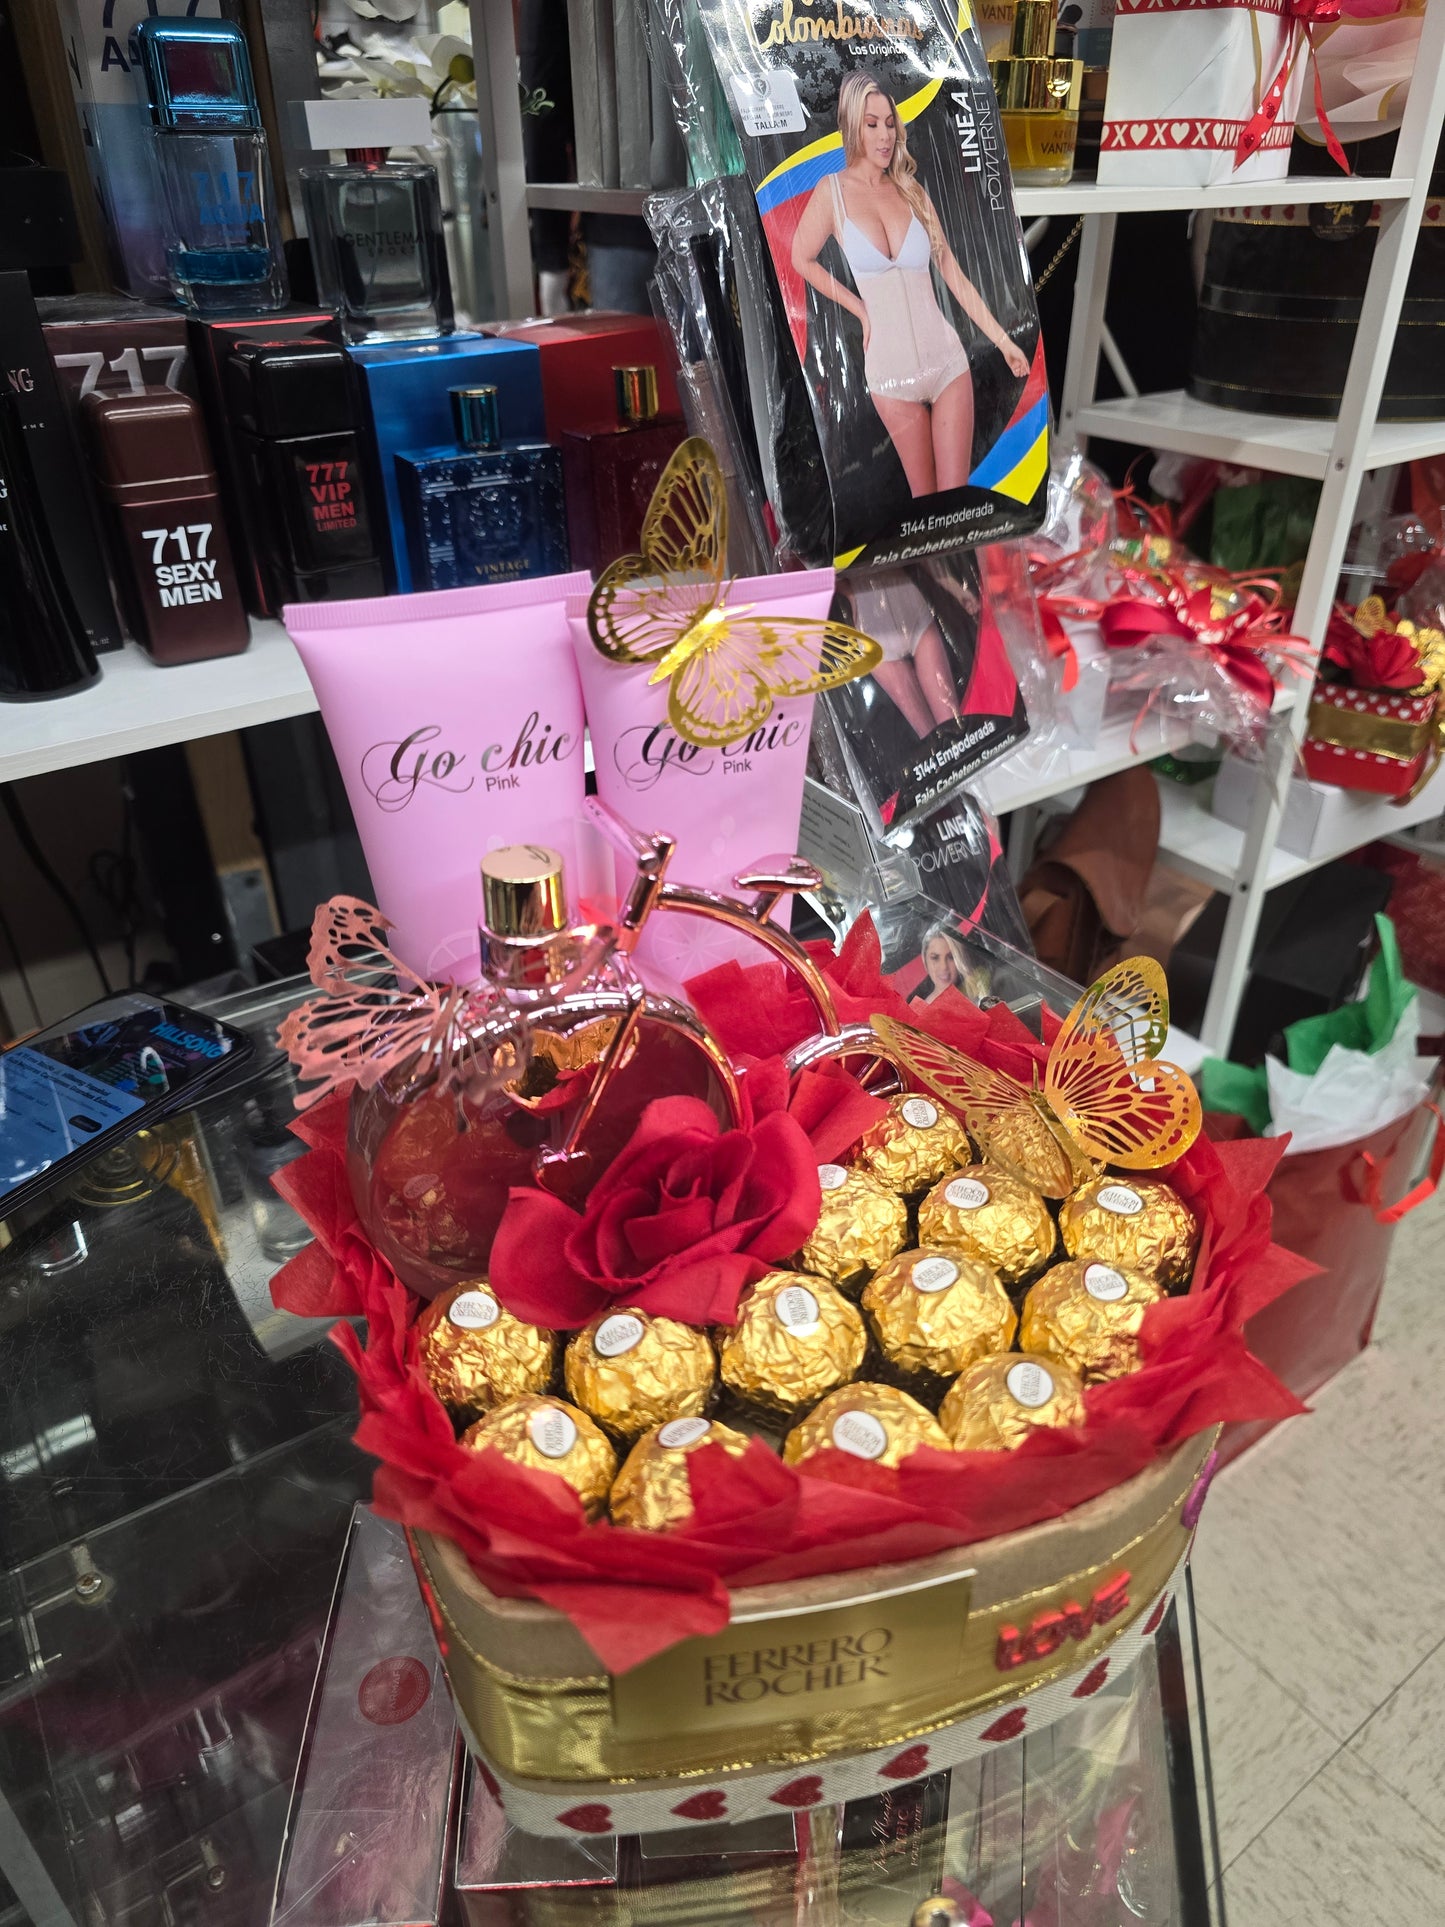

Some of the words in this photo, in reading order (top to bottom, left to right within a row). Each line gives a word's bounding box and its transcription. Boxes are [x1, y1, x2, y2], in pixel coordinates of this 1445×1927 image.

[848, 44, 868, 55] Las
[951, 92, 982, 173] LINEA
[973, 88, 1005, 211] POWERNET
[54, 345, 187, 398] 717
[306, 461, 348, 483] 777
[311, 482, 352, 504] VIP
[314, 501, 355, 521] MEN
[317, 517, 357, 532] LIMITED
[900, 518, 925, 538] 3144
[927, 501, 994, 531] Empoderada
[142, 523, 214, 565] 717
[901, 535, 964, 560] Cachetero
[155, 559, 217, 587] SEXY
[475, 558, 529, 575] VINTAGE
[160, 581, 223, 608] MEN
[360, 725, 475, 813] Go
[481, 712, 578, 772] chic
[723, 758, 753, 775] Pink
[912, 757, 937, 783] 3144
[935, 720, 996, 767] Empoderada
[485, 775, 520, 793] Pink
[936, 758, 981, 793] Cachetero
[149, 1021, 224, 1058] HILLSONG
[996, 1570, 1131, 1671] LOVE
[704, 1627, 893, 1681] FERRERO
[705, 1656, 893, 1707] ROCHER
